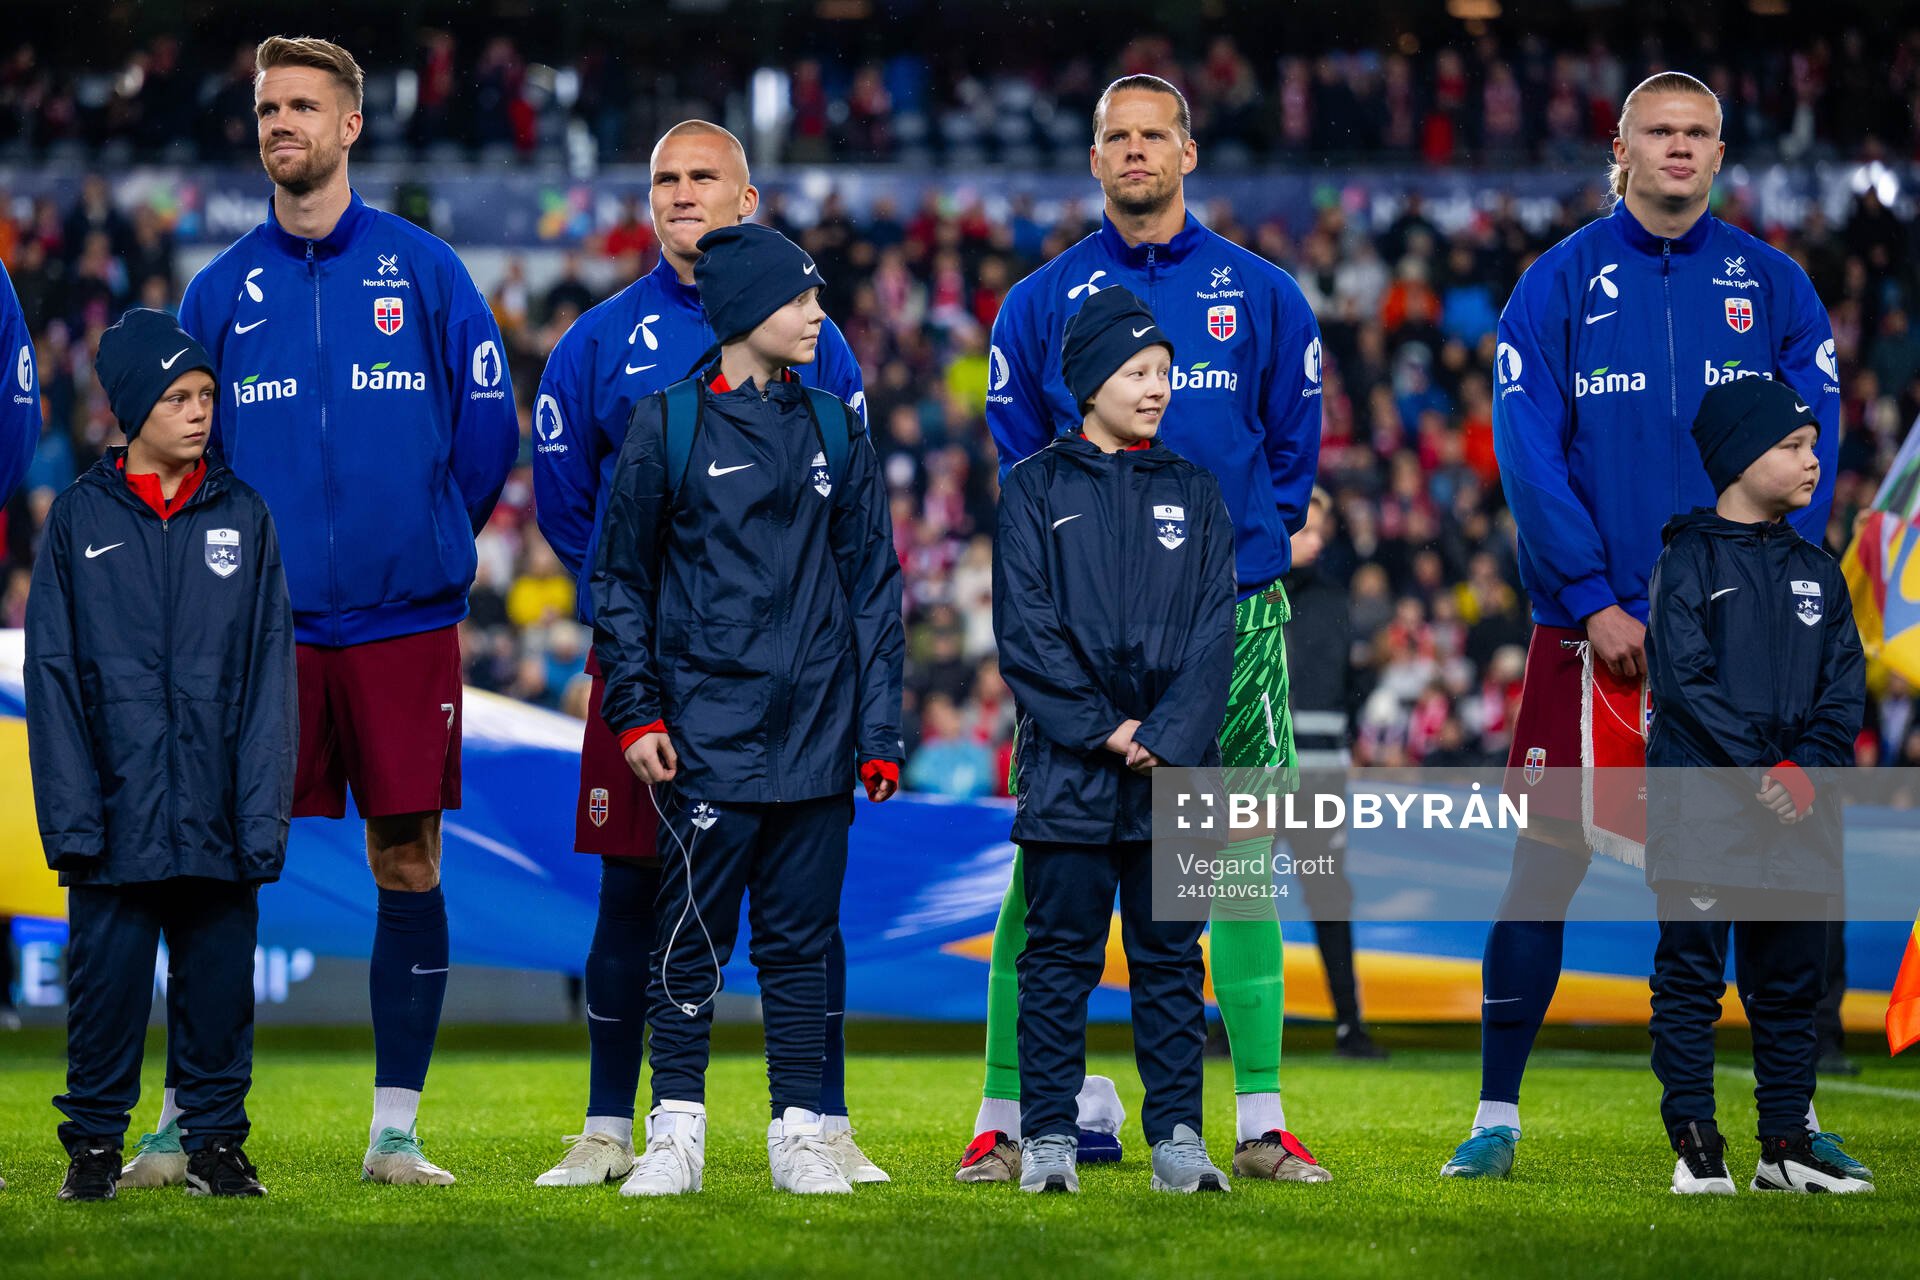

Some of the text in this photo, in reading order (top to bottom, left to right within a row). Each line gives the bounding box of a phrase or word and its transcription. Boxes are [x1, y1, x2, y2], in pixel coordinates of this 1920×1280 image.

[363, 279, 385, 287] Norsk
[1712, 277, 1733, 287] Norsk
[1196, 289, 1244, 299] Norsk Tipping
[352, 362, 426, 391] bama
[1172, 365, 1238, 392] bama
[1575, 371, 1646, 398] bama
